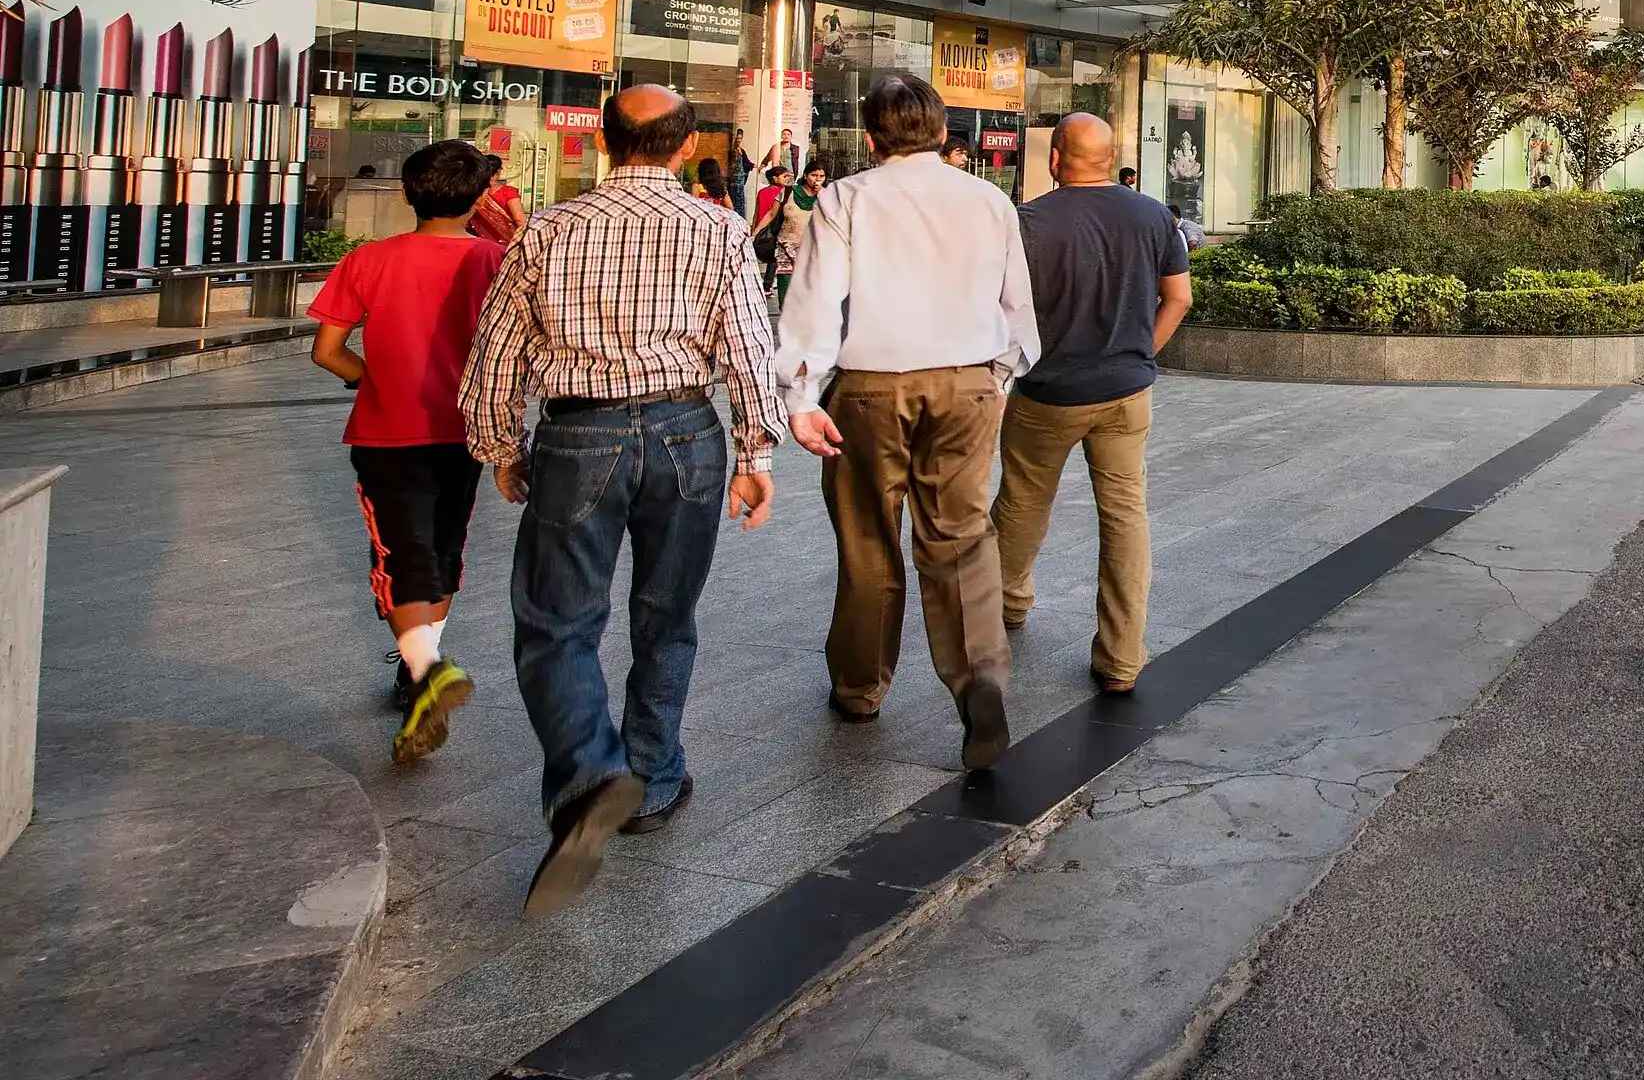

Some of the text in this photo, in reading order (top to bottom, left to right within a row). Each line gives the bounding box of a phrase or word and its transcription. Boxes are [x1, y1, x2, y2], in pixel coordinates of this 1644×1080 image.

[488, 7, 555, 40] DISCOUNT
[592, 58, 609, 72] EXIT
[940, 43, 988, 72] MOVIES
[320, 70, 540, 101] THE BODY SHOP
[946, 70, 987, 90] DISCOUNT
[550, 110, 600, 127] NO ENTRY
[1005, 101, 1021, 110] ENTRY
[986, 134, 1014, 147] ENTRY
[59, 214, 73, 251] BROWN
[109, 214, 121, 249] BROWN
[161, 213, 172, 247] BROWN
